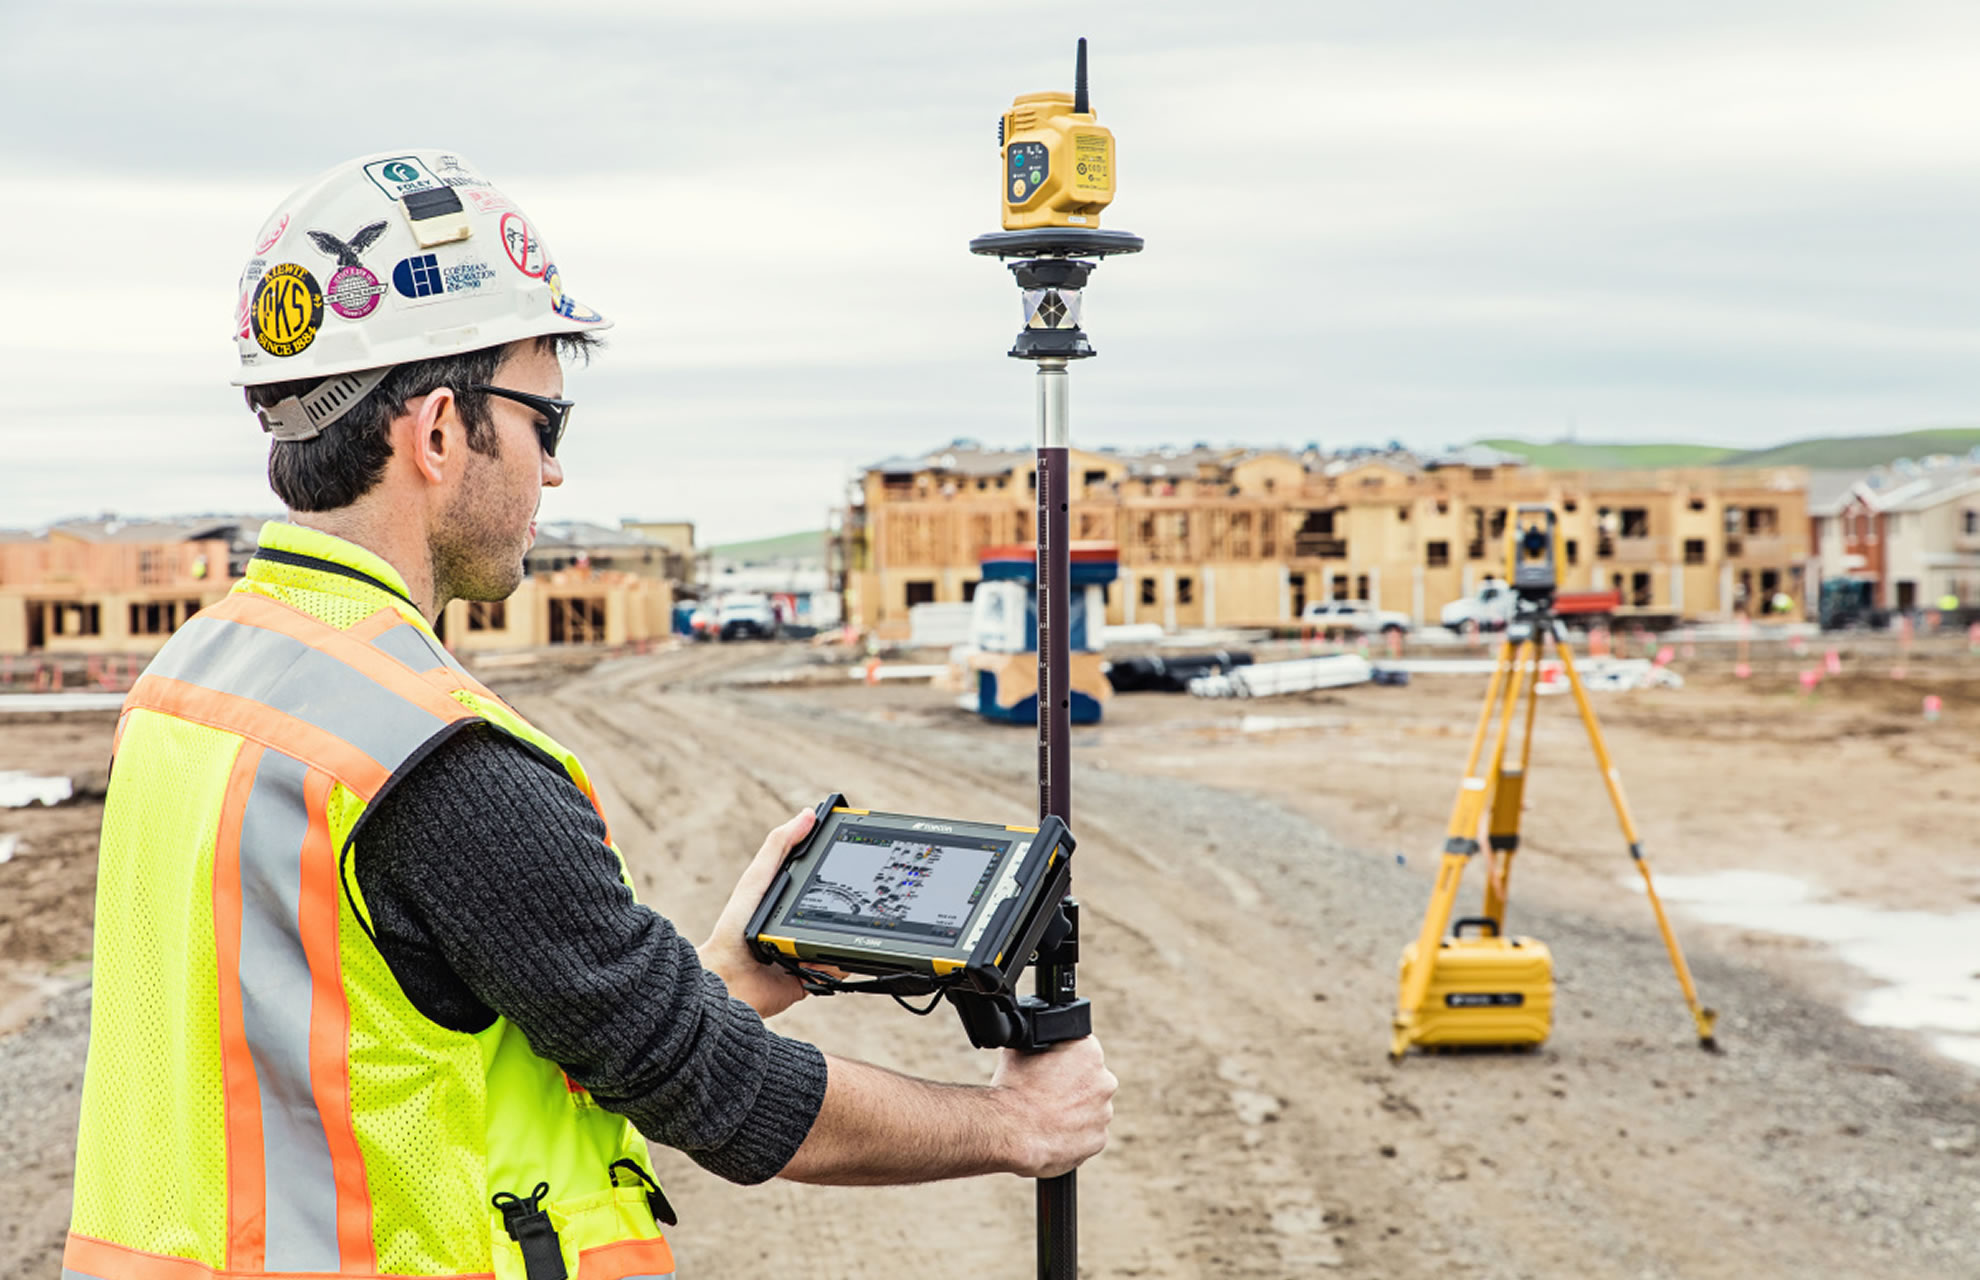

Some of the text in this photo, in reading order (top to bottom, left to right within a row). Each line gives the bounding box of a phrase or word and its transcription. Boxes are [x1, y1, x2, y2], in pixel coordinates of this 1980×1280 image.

[396, 179, 432, 192] FOLEY
[264, 263, 309, 283] KIEWIT
[257, 325, 317, 355] SINCE 1884
